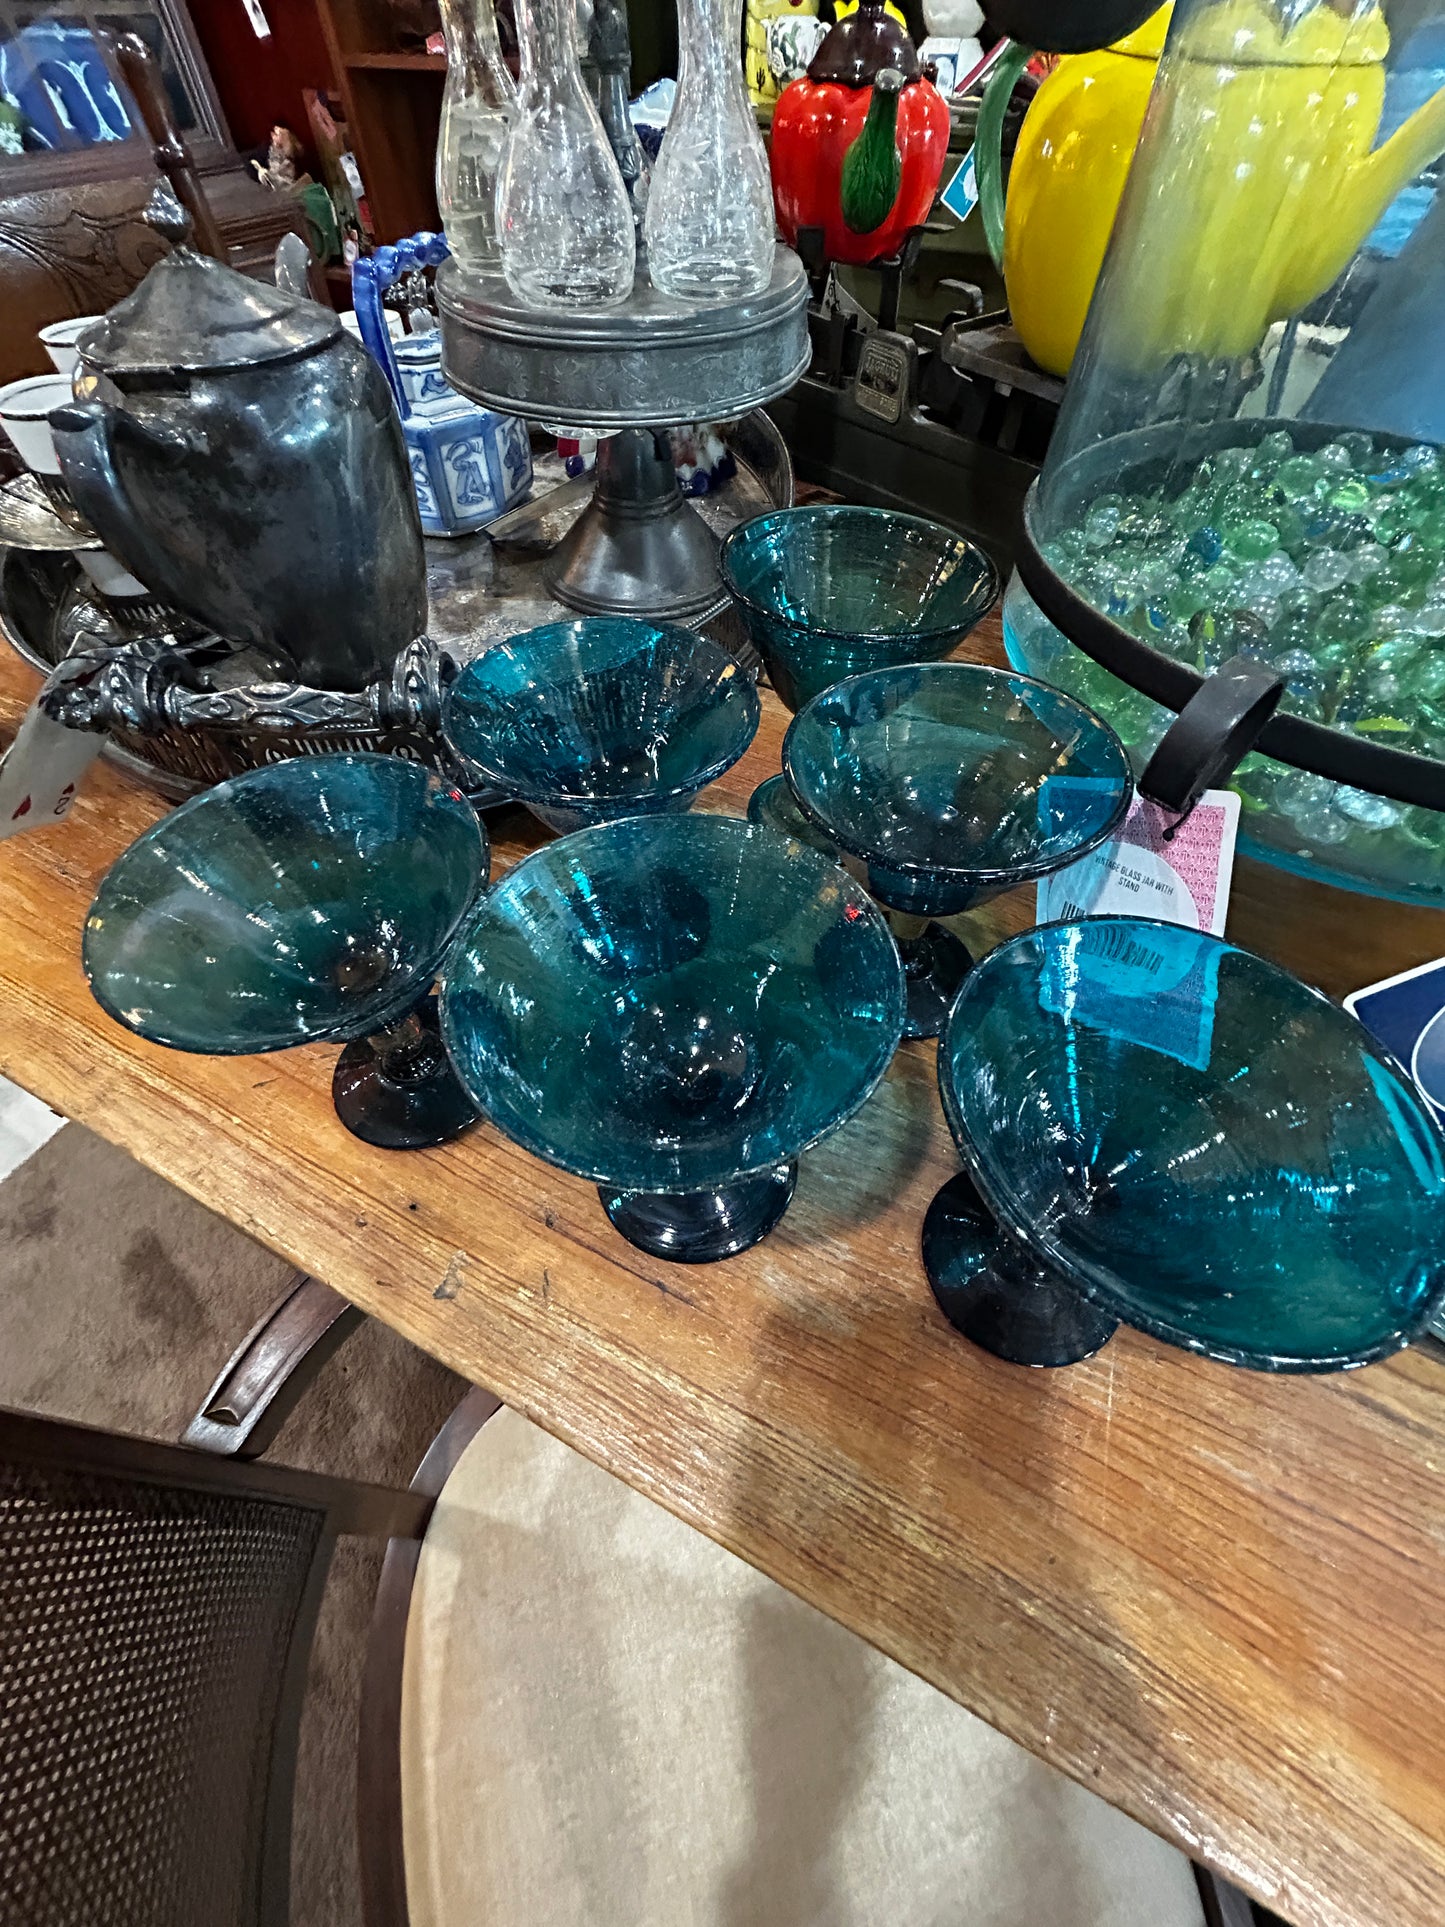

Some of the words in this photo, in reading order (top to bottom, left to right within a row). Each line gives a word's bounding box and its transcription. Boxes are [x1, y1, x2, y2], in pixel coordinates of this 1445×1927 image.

[54, 797, 70, 815] 2
[1095, 855, 1121, 872] VINTAGE
[1120, 866, 1142, 881] GLASS
[1141, 875, 1155, 887] JAR
[1155, 881, 1175, 895] WITH
[1118, 877, 1140, 893] STAND
